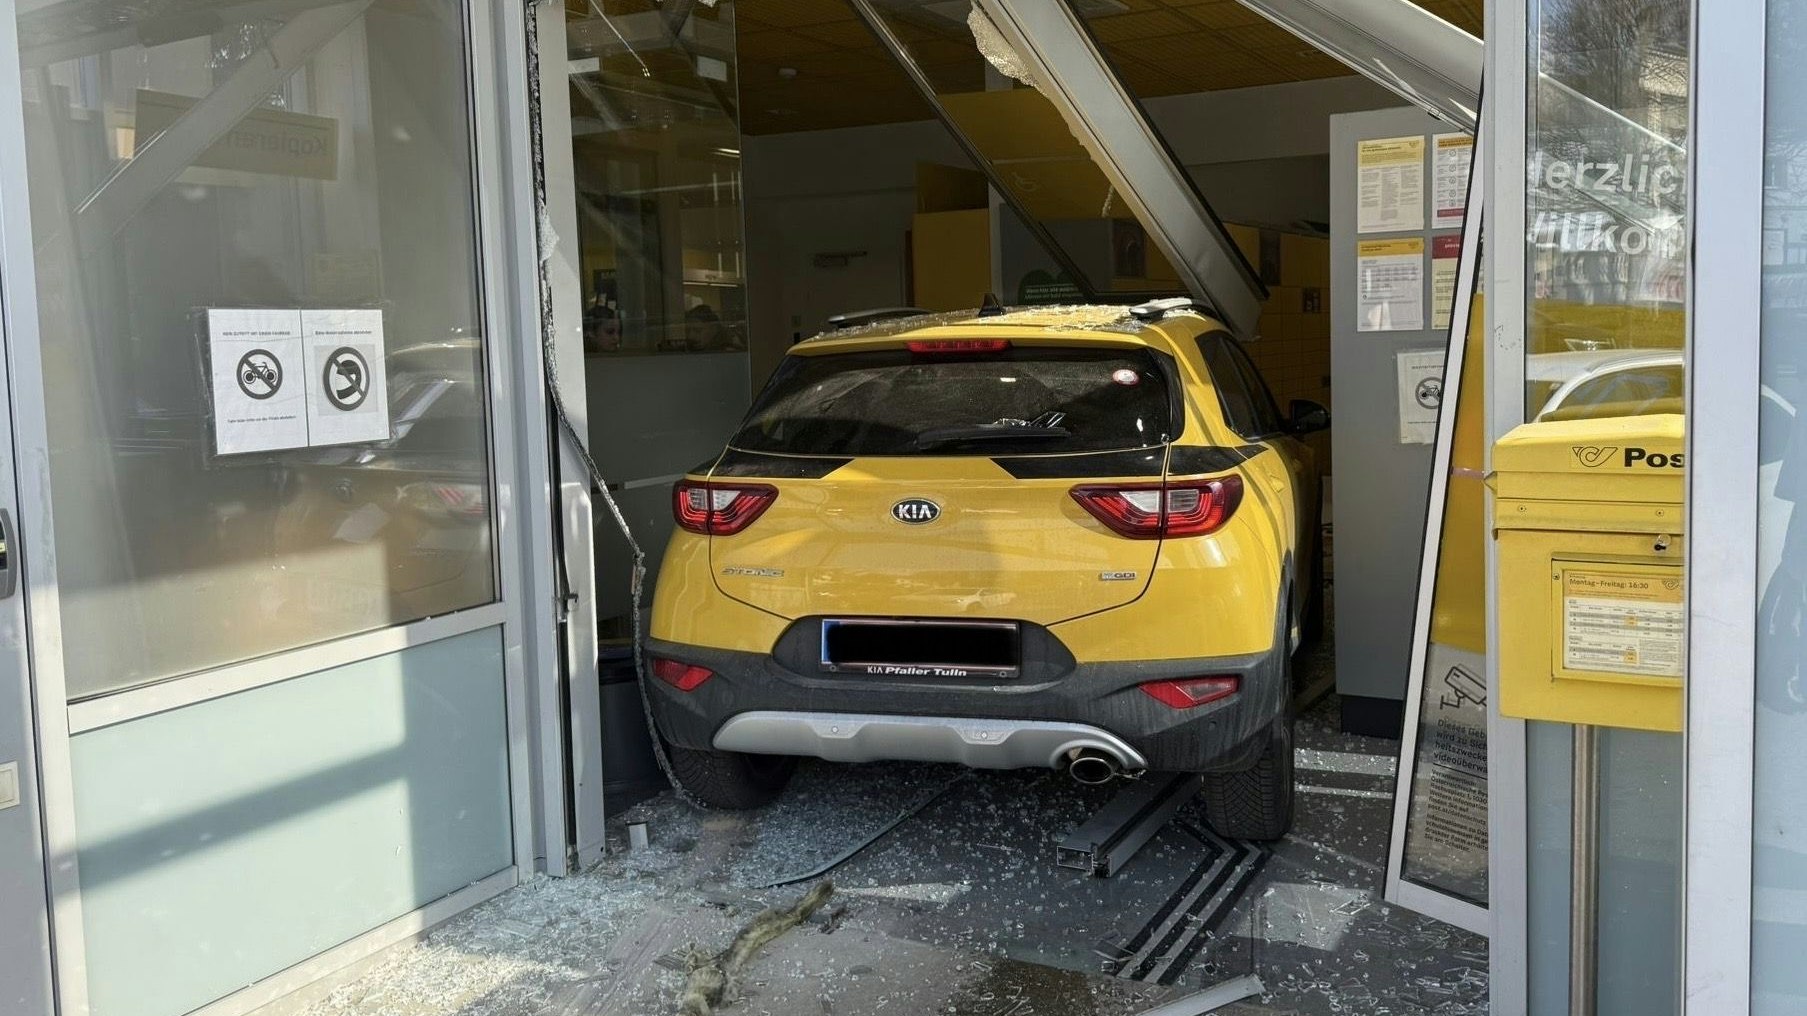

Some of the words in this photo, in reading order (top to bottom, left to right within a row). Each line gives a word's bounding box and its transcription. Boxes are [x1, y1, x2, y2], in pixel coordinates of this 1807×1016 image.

[1534, 150, 1687, 194] erzlic
[898, 504, 932, 519] KIA
[867, 665, 883, 674] KIA
[1438, 719, 1466, 733] Dieses
[1436, 731, 1455, 742] wird
